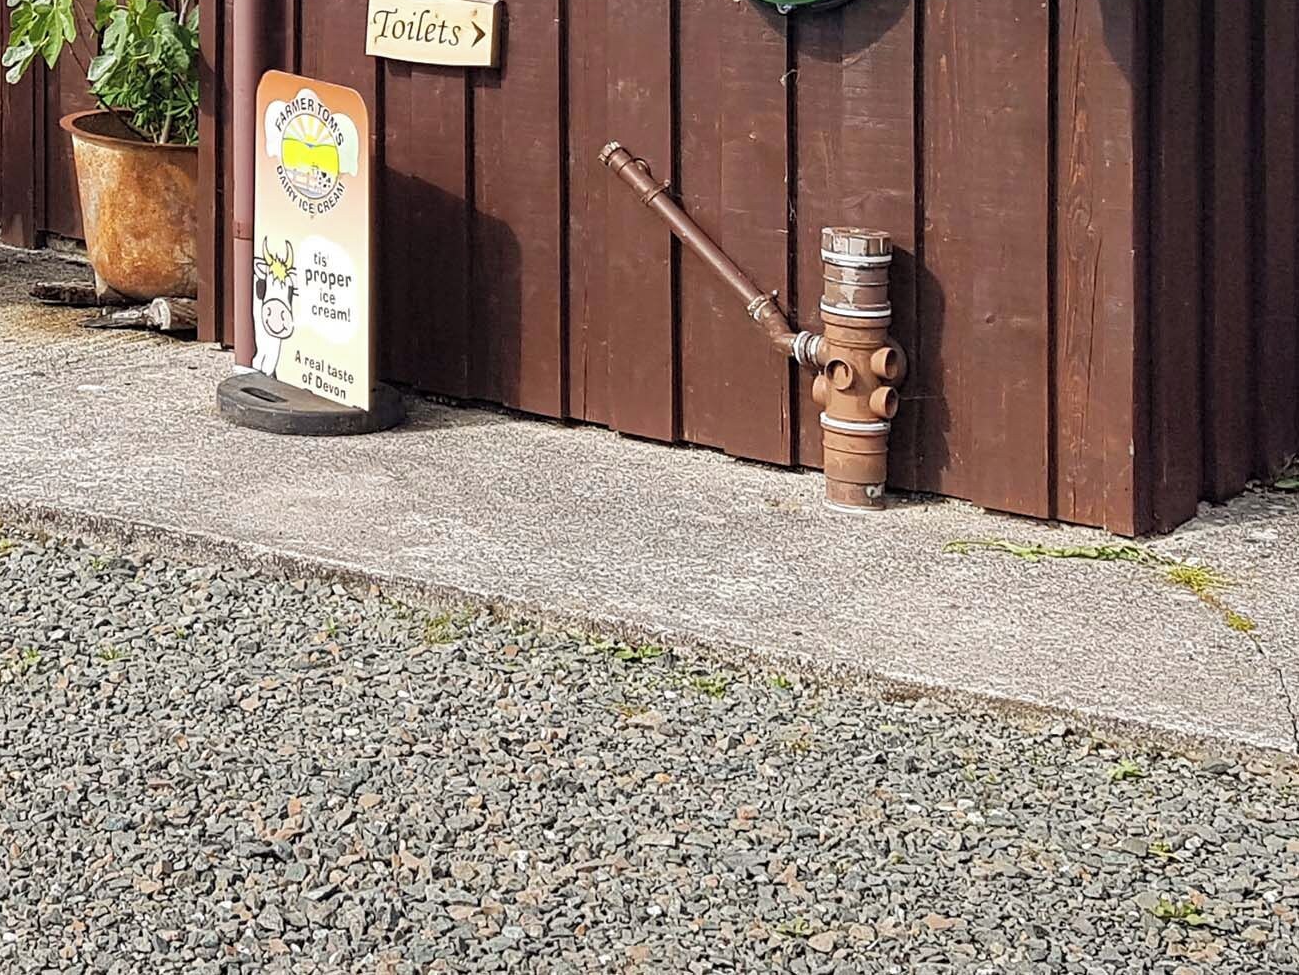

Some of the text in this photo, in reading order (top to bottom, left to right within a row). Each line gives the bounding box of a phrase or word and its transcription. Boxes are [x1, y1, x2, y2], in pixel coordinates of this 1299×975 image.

[372, 7, 462, 47] Toilets
[274, 97, 345, 147] FARMER TOM'S
[276, 165, 346, 214] DAIRY ICE CREAM
[305, 268, 352, 290] proper
[319, 288, 336, 305] ice
[311, 304, 351, 323] cream!
[295, 350, 355, 385] A real taste
[302, 372, 347, 400] of Devon
